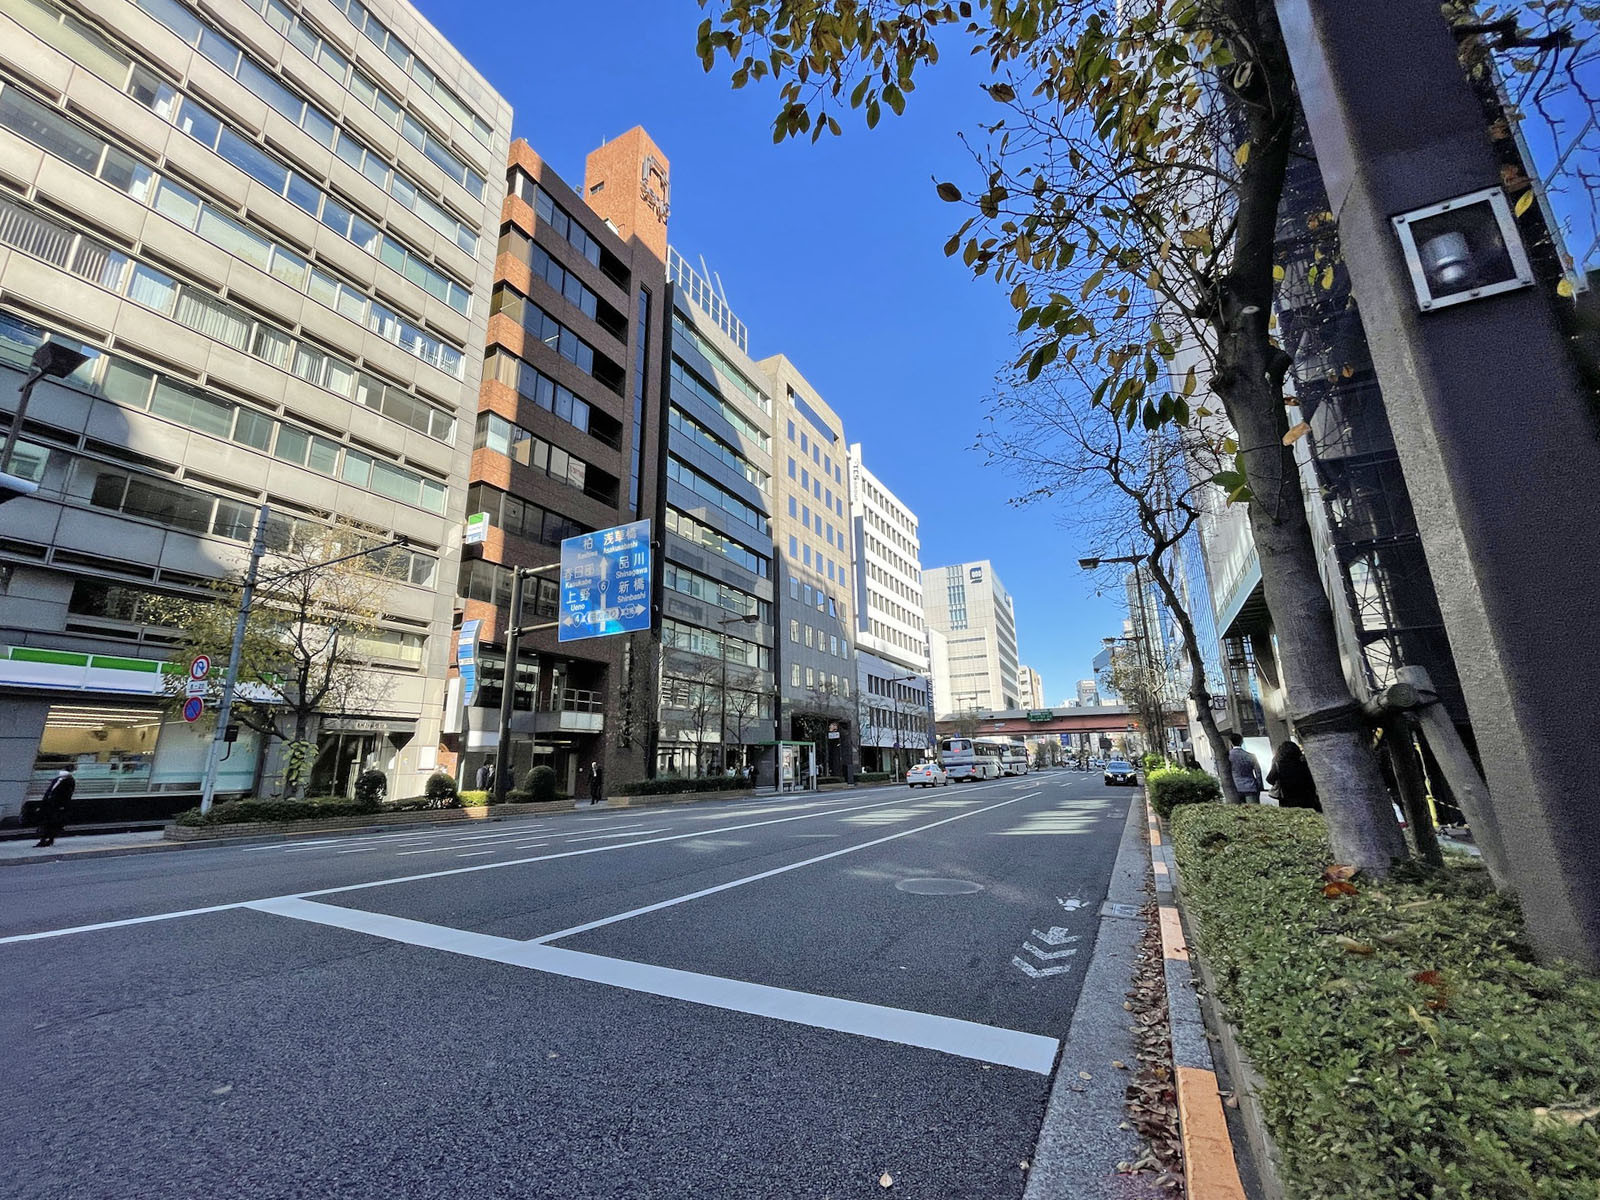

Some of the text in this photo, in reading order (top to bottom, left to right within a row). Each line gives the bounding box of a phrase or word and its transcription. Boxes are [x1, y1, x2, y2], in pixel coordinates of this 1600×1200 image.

[619, 552, 644, 569] 品川
[615, 567, 648, 579] Shinagawa
[618, 578, 645, 594] 新橋
[566, 588, 591, 605] 上野
[617, 591, 646, 603] Shinbashi
[570, 604, 586, 612] Ueno
